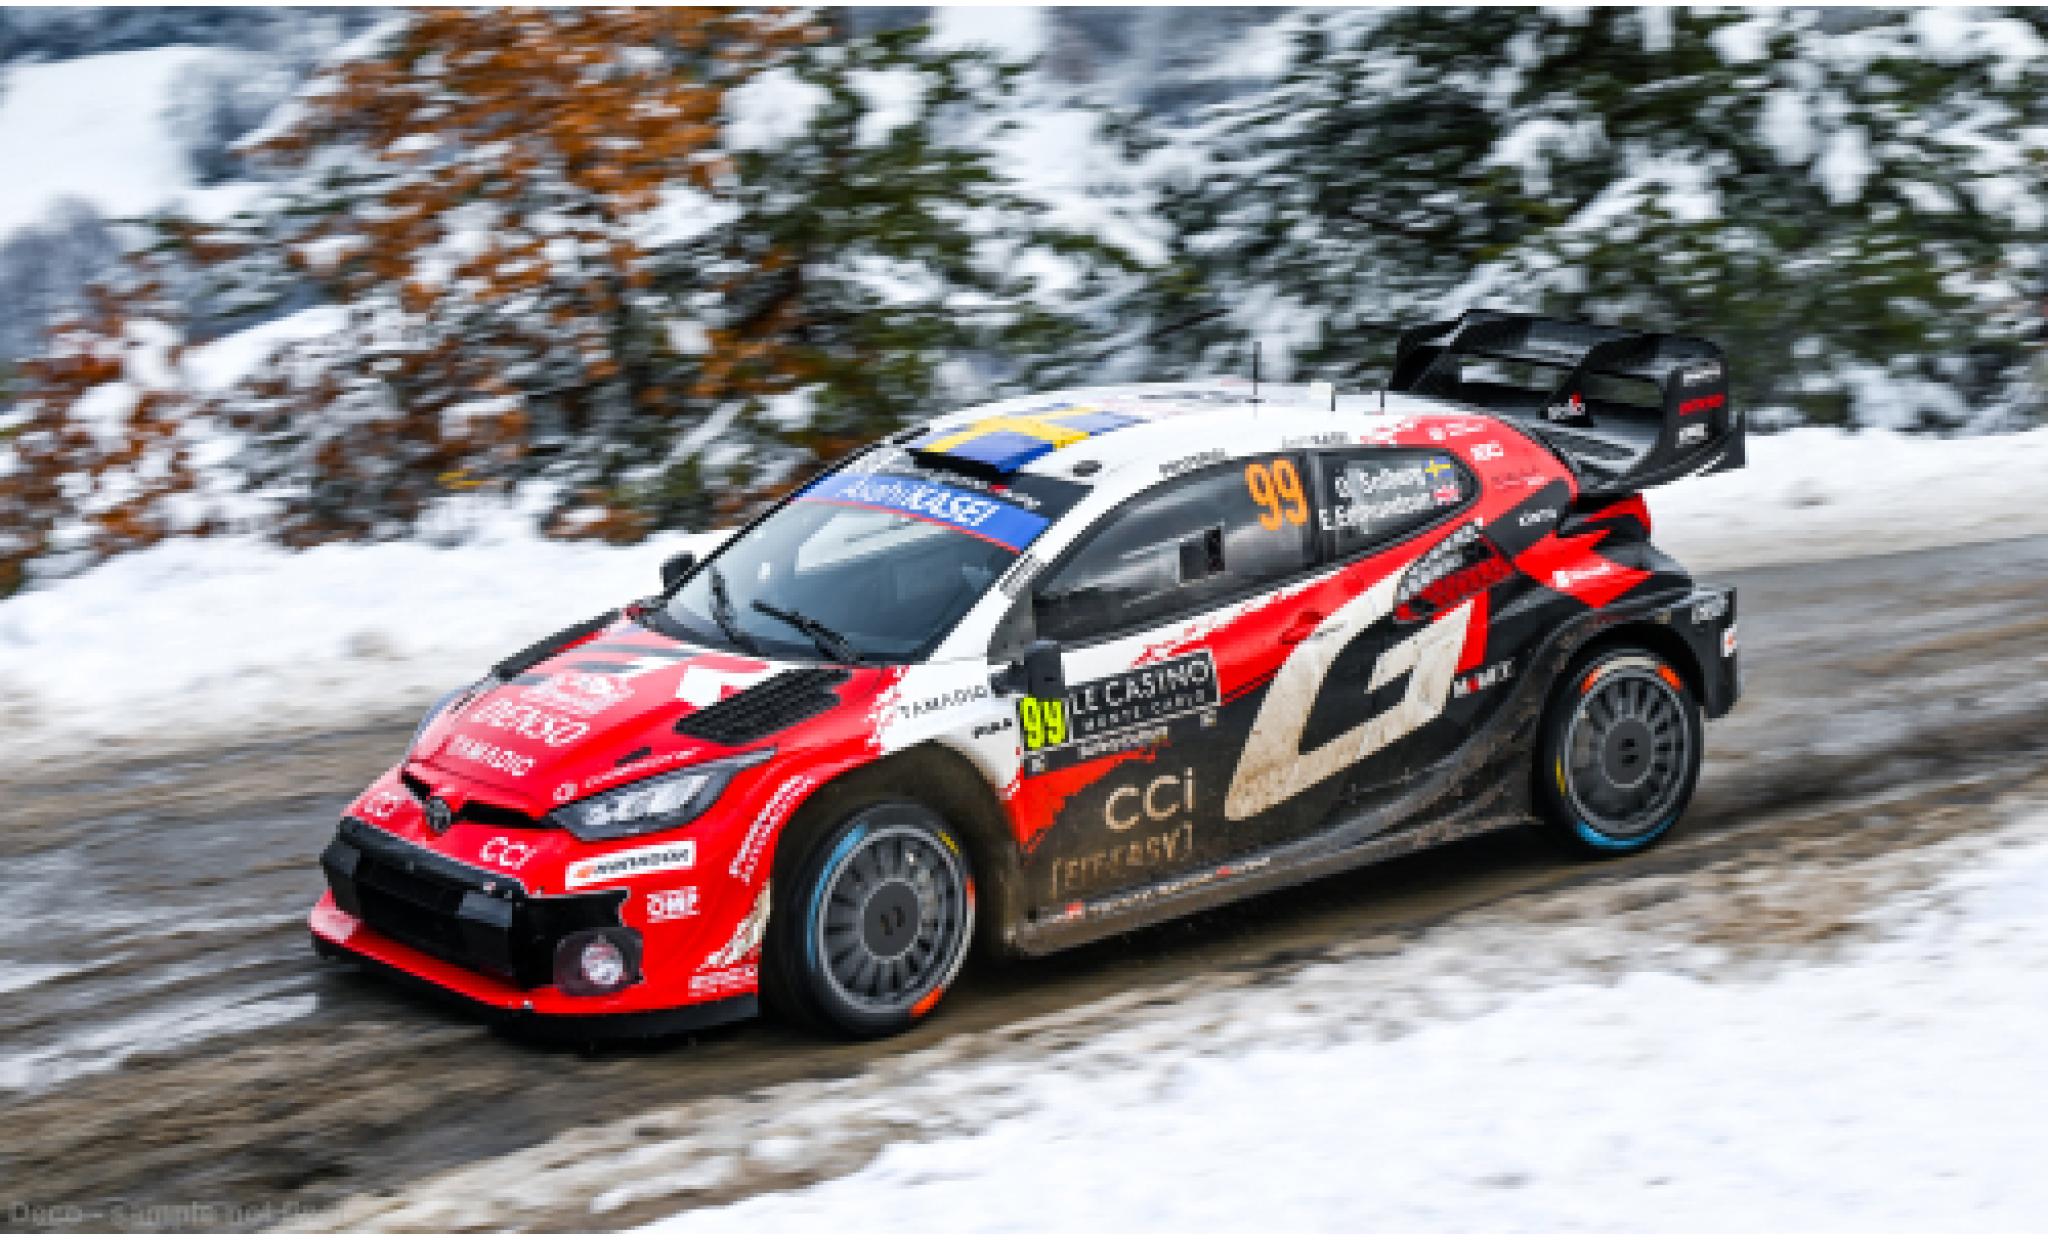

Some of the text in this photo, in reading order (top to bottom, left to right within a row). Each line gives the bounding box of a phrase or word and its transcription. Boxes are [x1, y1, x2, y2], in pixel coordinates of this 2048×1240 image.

[1245, 457, 1309, 531] 99
[899, 681, 990, 719] TAMADIC
[1070, 658, 1212, 716] LE CASINO
[470, 699, 589, 749] DENSO
[1021, 698, 1069, 751] 99
[444, 735, 534, 777] TAMADIC
